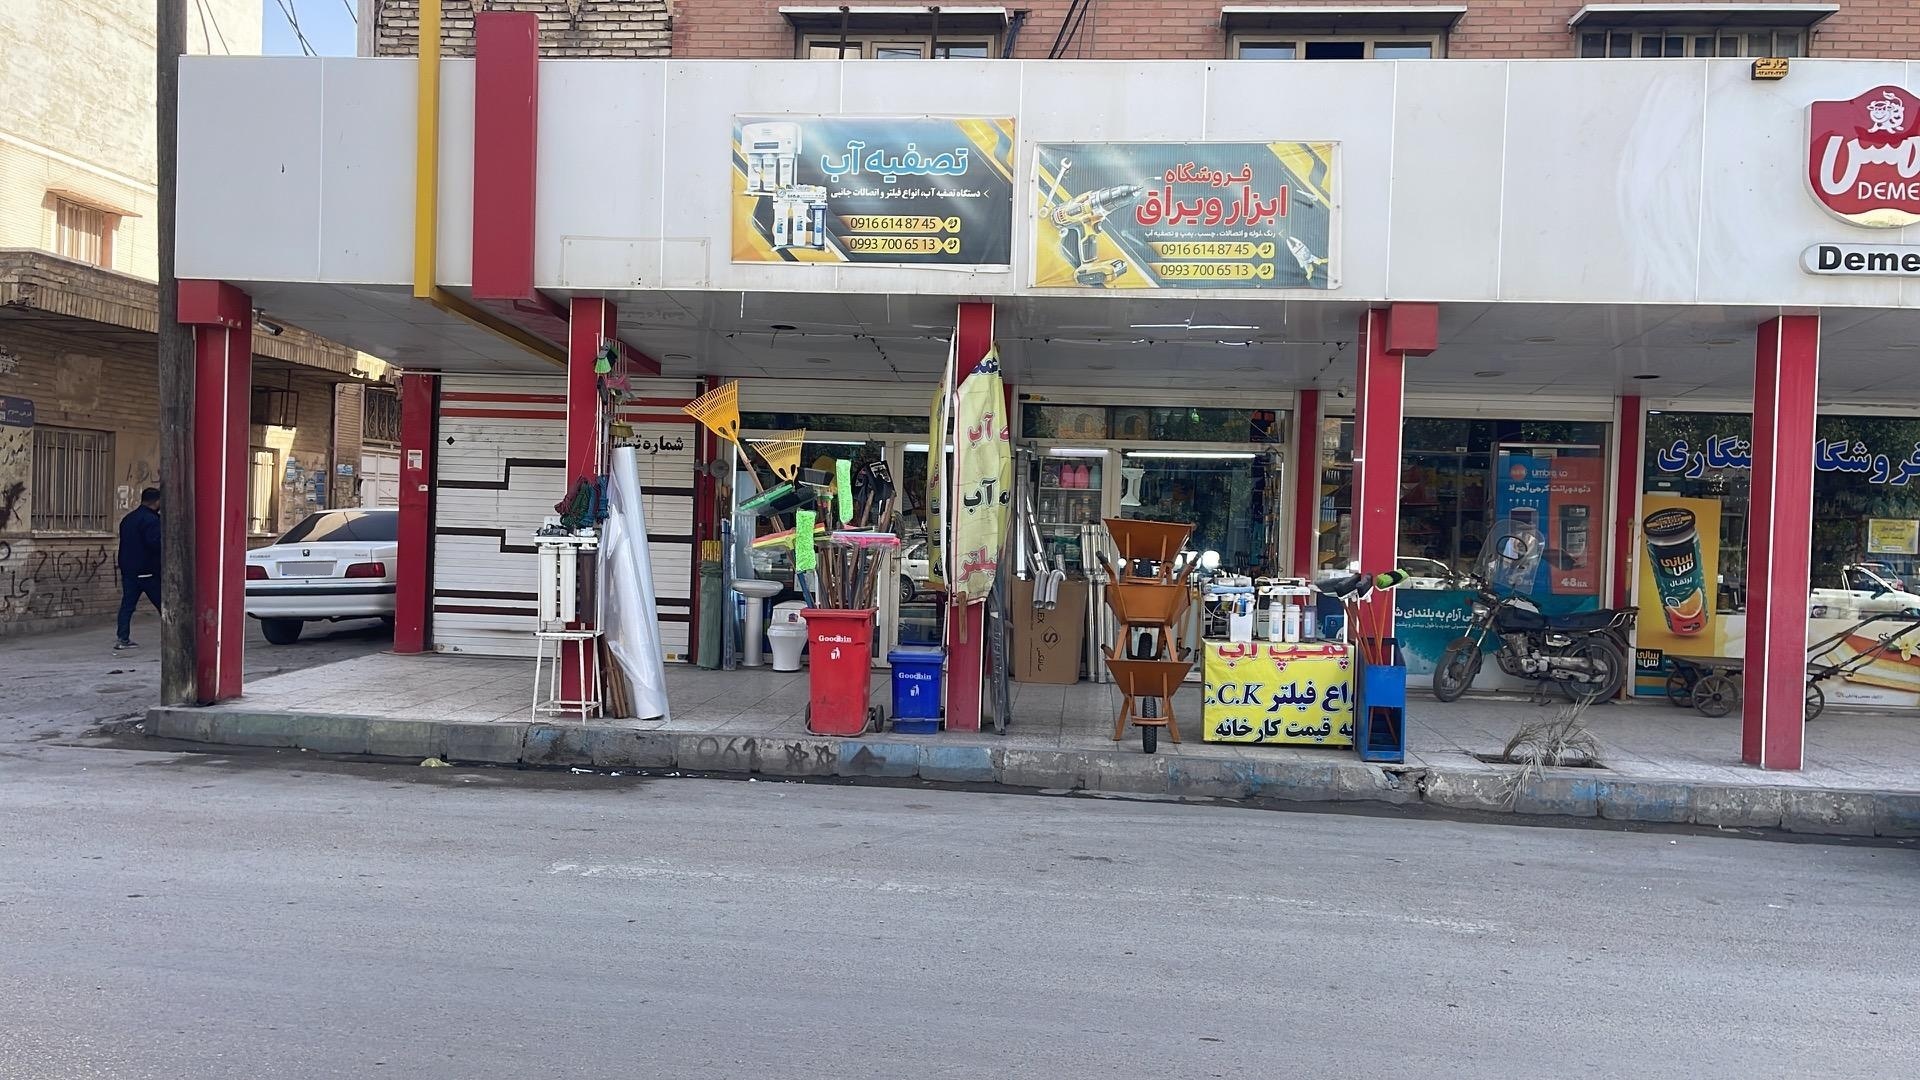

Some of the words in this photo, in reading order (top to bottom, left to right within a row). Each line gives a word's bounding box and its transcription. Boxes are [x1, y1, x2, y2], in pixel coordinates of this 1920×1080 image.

[821, 140, 865, 183] آب
[865, 143, 969, 183] تصفیه
[1165, 161, 1252, 187] فروشگاه
[830, 187, 852, 199] جانبی
[853, 187, 880, 198] اتصالات
[885, 187, 902, 199] فیلتر
[902, 188, 920, 199] انواع
[936, 188, 957, 199] تصفیه
[957, 188, 981, 198] دستگاه
[1135, 185, 1204, 226] یراق
[1224, 185, 1288, 226] ابزار
[850, 217, 879, 229] 0916
[881, 218, 903, 229] 614
[905, 218, 919, 229] 87
[921, 218, 936, 229] 45
[850, 238, 878, 250] 0993
[881, 239, 902, 250] 700
[904, 239, 919, 250] 65
[922, 239, 935, 250] 13
[1161, 244, 1190, 255] 0916
[1193, 244, 1215, 255] 614
[1217, 244, 1232, 255] 87
[1234, 244, 1249, 255] 45
[1160, 264, 1190, 276] 0993
[1193, 265, 1214, 276] 700
[1216, 265, 1231, 276] 65
[1235, 265, 1249, 276] 13
[967, 412, 994, 449] آب
[963, 477, 997, 515] آب
[957, 545, 998, 582] یلتر
[1403, 608, 1435, 621] بلندای
[1435, 611, 1446, 621] به
[1446, 607, 1462, 622] آرام
[818, 634, 852, 643] Goodbin
[898, 671, 932, 681] Goodbin
[1267, 680, 1317, 712] فیلتر
[1215, 717, 1282, 743] کارخانه
[1285, 716, 1331, 741] قیمت
